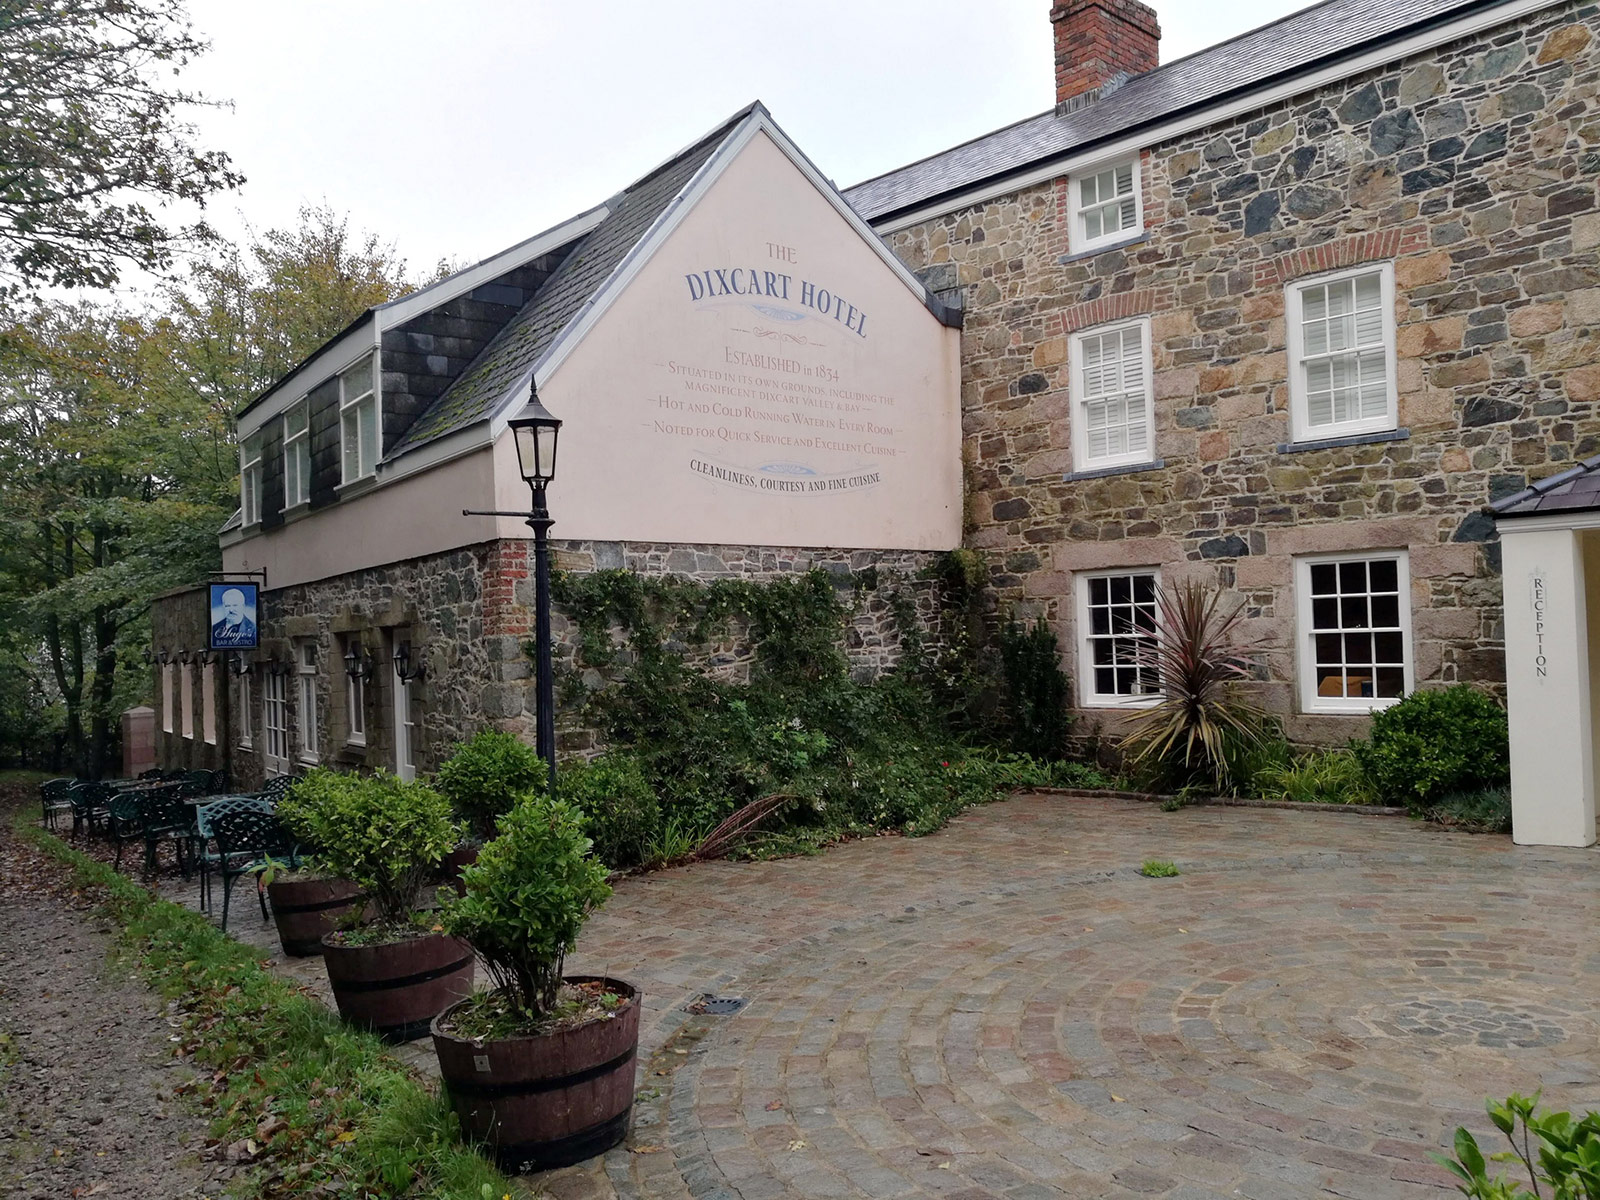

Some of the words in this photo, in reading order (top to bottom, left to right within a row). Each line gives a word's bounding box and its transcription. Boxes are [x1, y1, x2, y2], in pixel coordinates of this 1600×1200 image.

[766, 242, 798, 264] THE
[685, 268, 792, 301] DIXCART
[800, 280, 867, 339] HOTEL
[724, 372, 736, 383] IN
[738, 375, 753, 386] ITS
[755, 377, 779, 389] OWN
[829, 389, 877, 404] INCLUDING
[879, 395, 896, 407] THE
[803, 364, 812, 376] in
[815, 364, 840, 382] 1834
[684, 380, 757, 399] MAGNIFICENT
[759, 391, 800, 405] DIXCART
[803, 396, 835, 410] VALLEY
[845, 404, 861, 413] BAY
[687, 403, 710, 414] AND
[696, 427, 715, 438] FOR
[793, 438, 813, 448] AND
[690, 458, 758, 488] CLEANLINESS,
[760, 477, 806, 492] COURTESY
[808, 480, 826, 492] AND
[828, 477, 847, 491] FINE
[849, 472, 881, 488] CUISINE
[1534, 578, 1547, 677] RECEPTION
